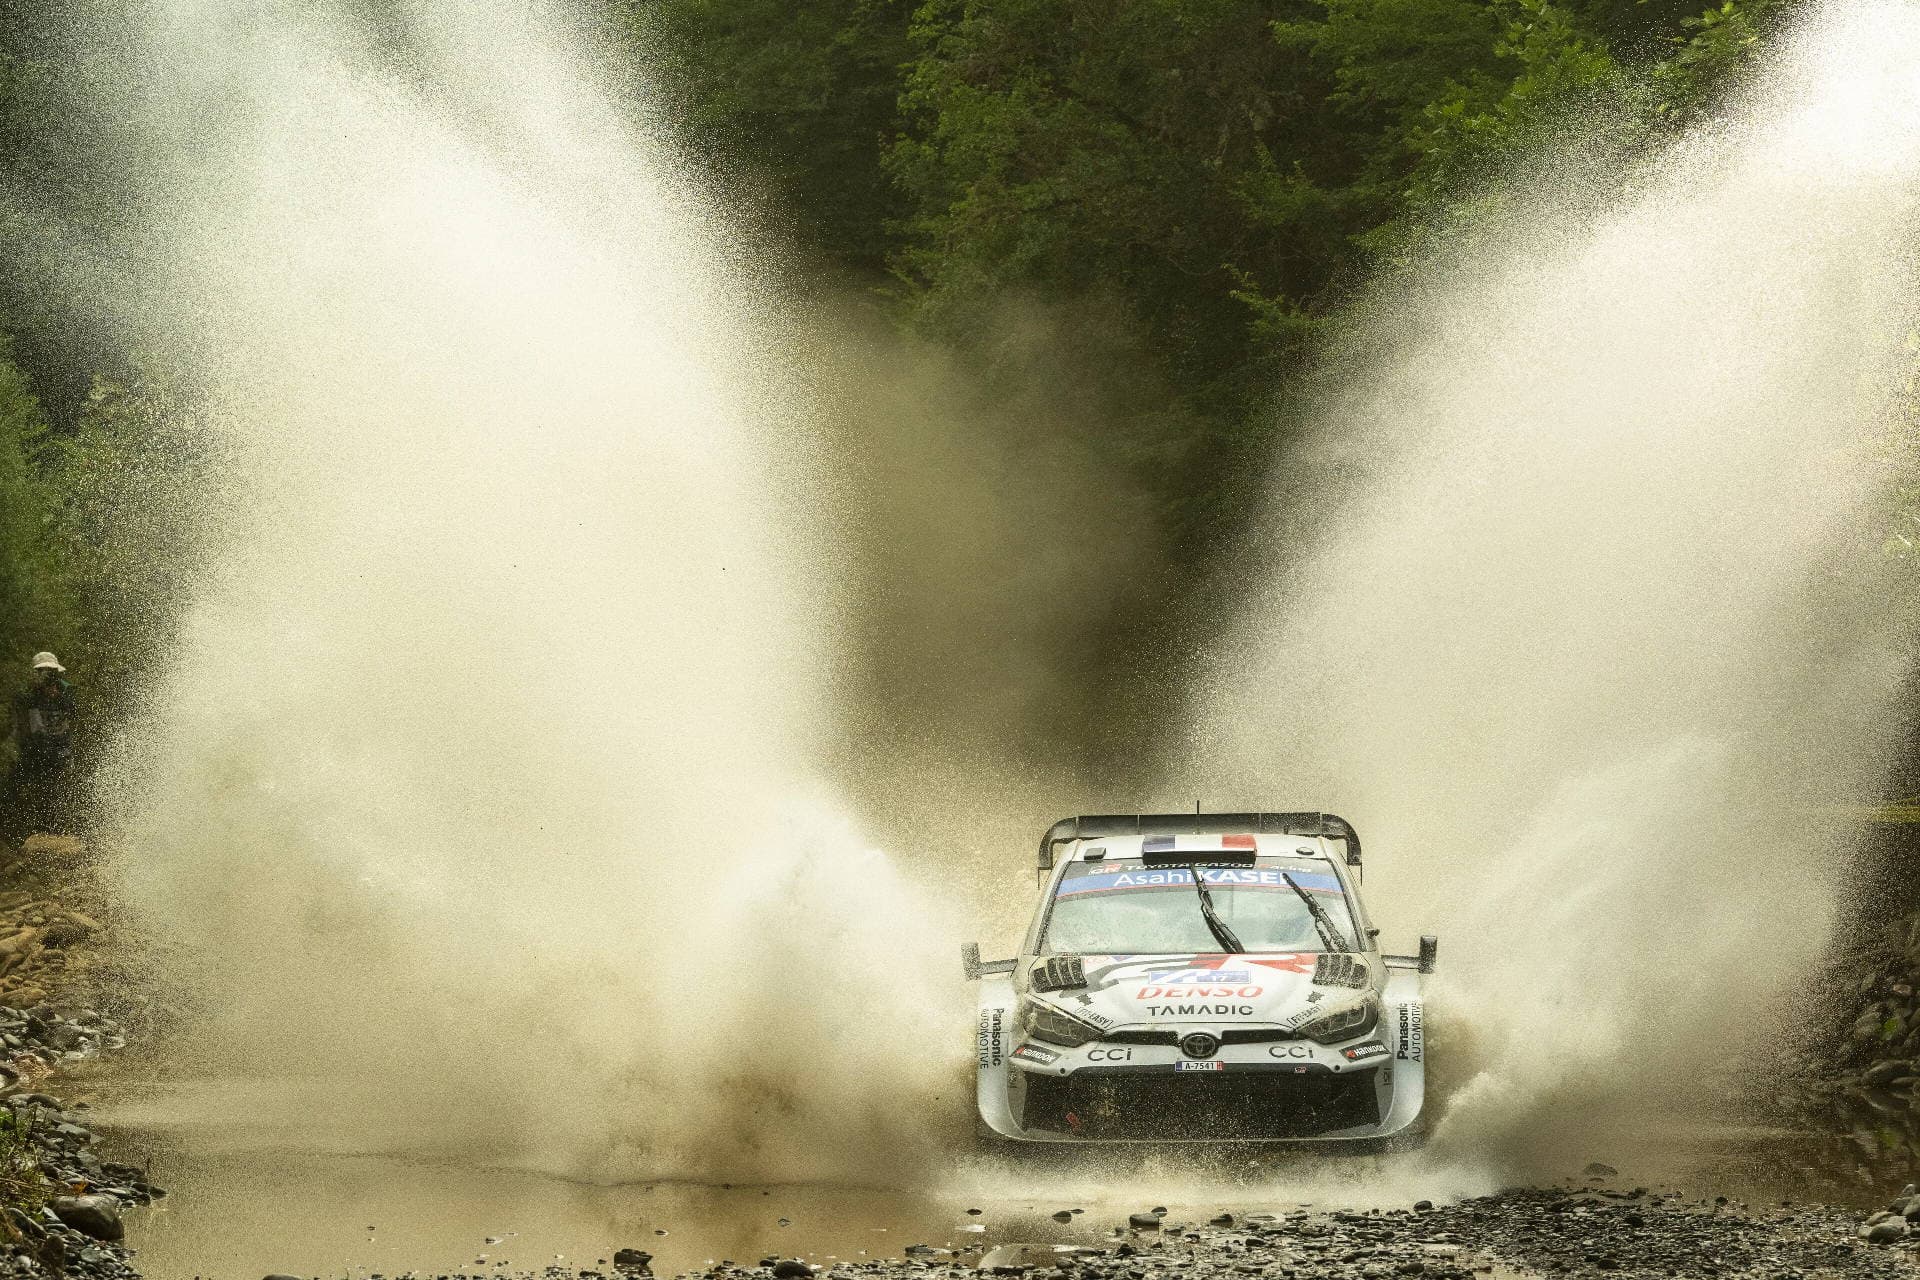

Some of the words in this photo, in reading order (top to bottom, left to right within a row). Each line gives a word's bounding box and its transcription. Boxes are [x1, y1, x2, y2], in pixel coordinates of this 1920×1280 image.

[1137, 986, 1263, 999] DENSO
[1146, 1004, 1253, 1016] TAMADIC
[1396, 1002, 1409, 1060] Panasonic
[1185, 1062, 1215, 1070] A-7541
